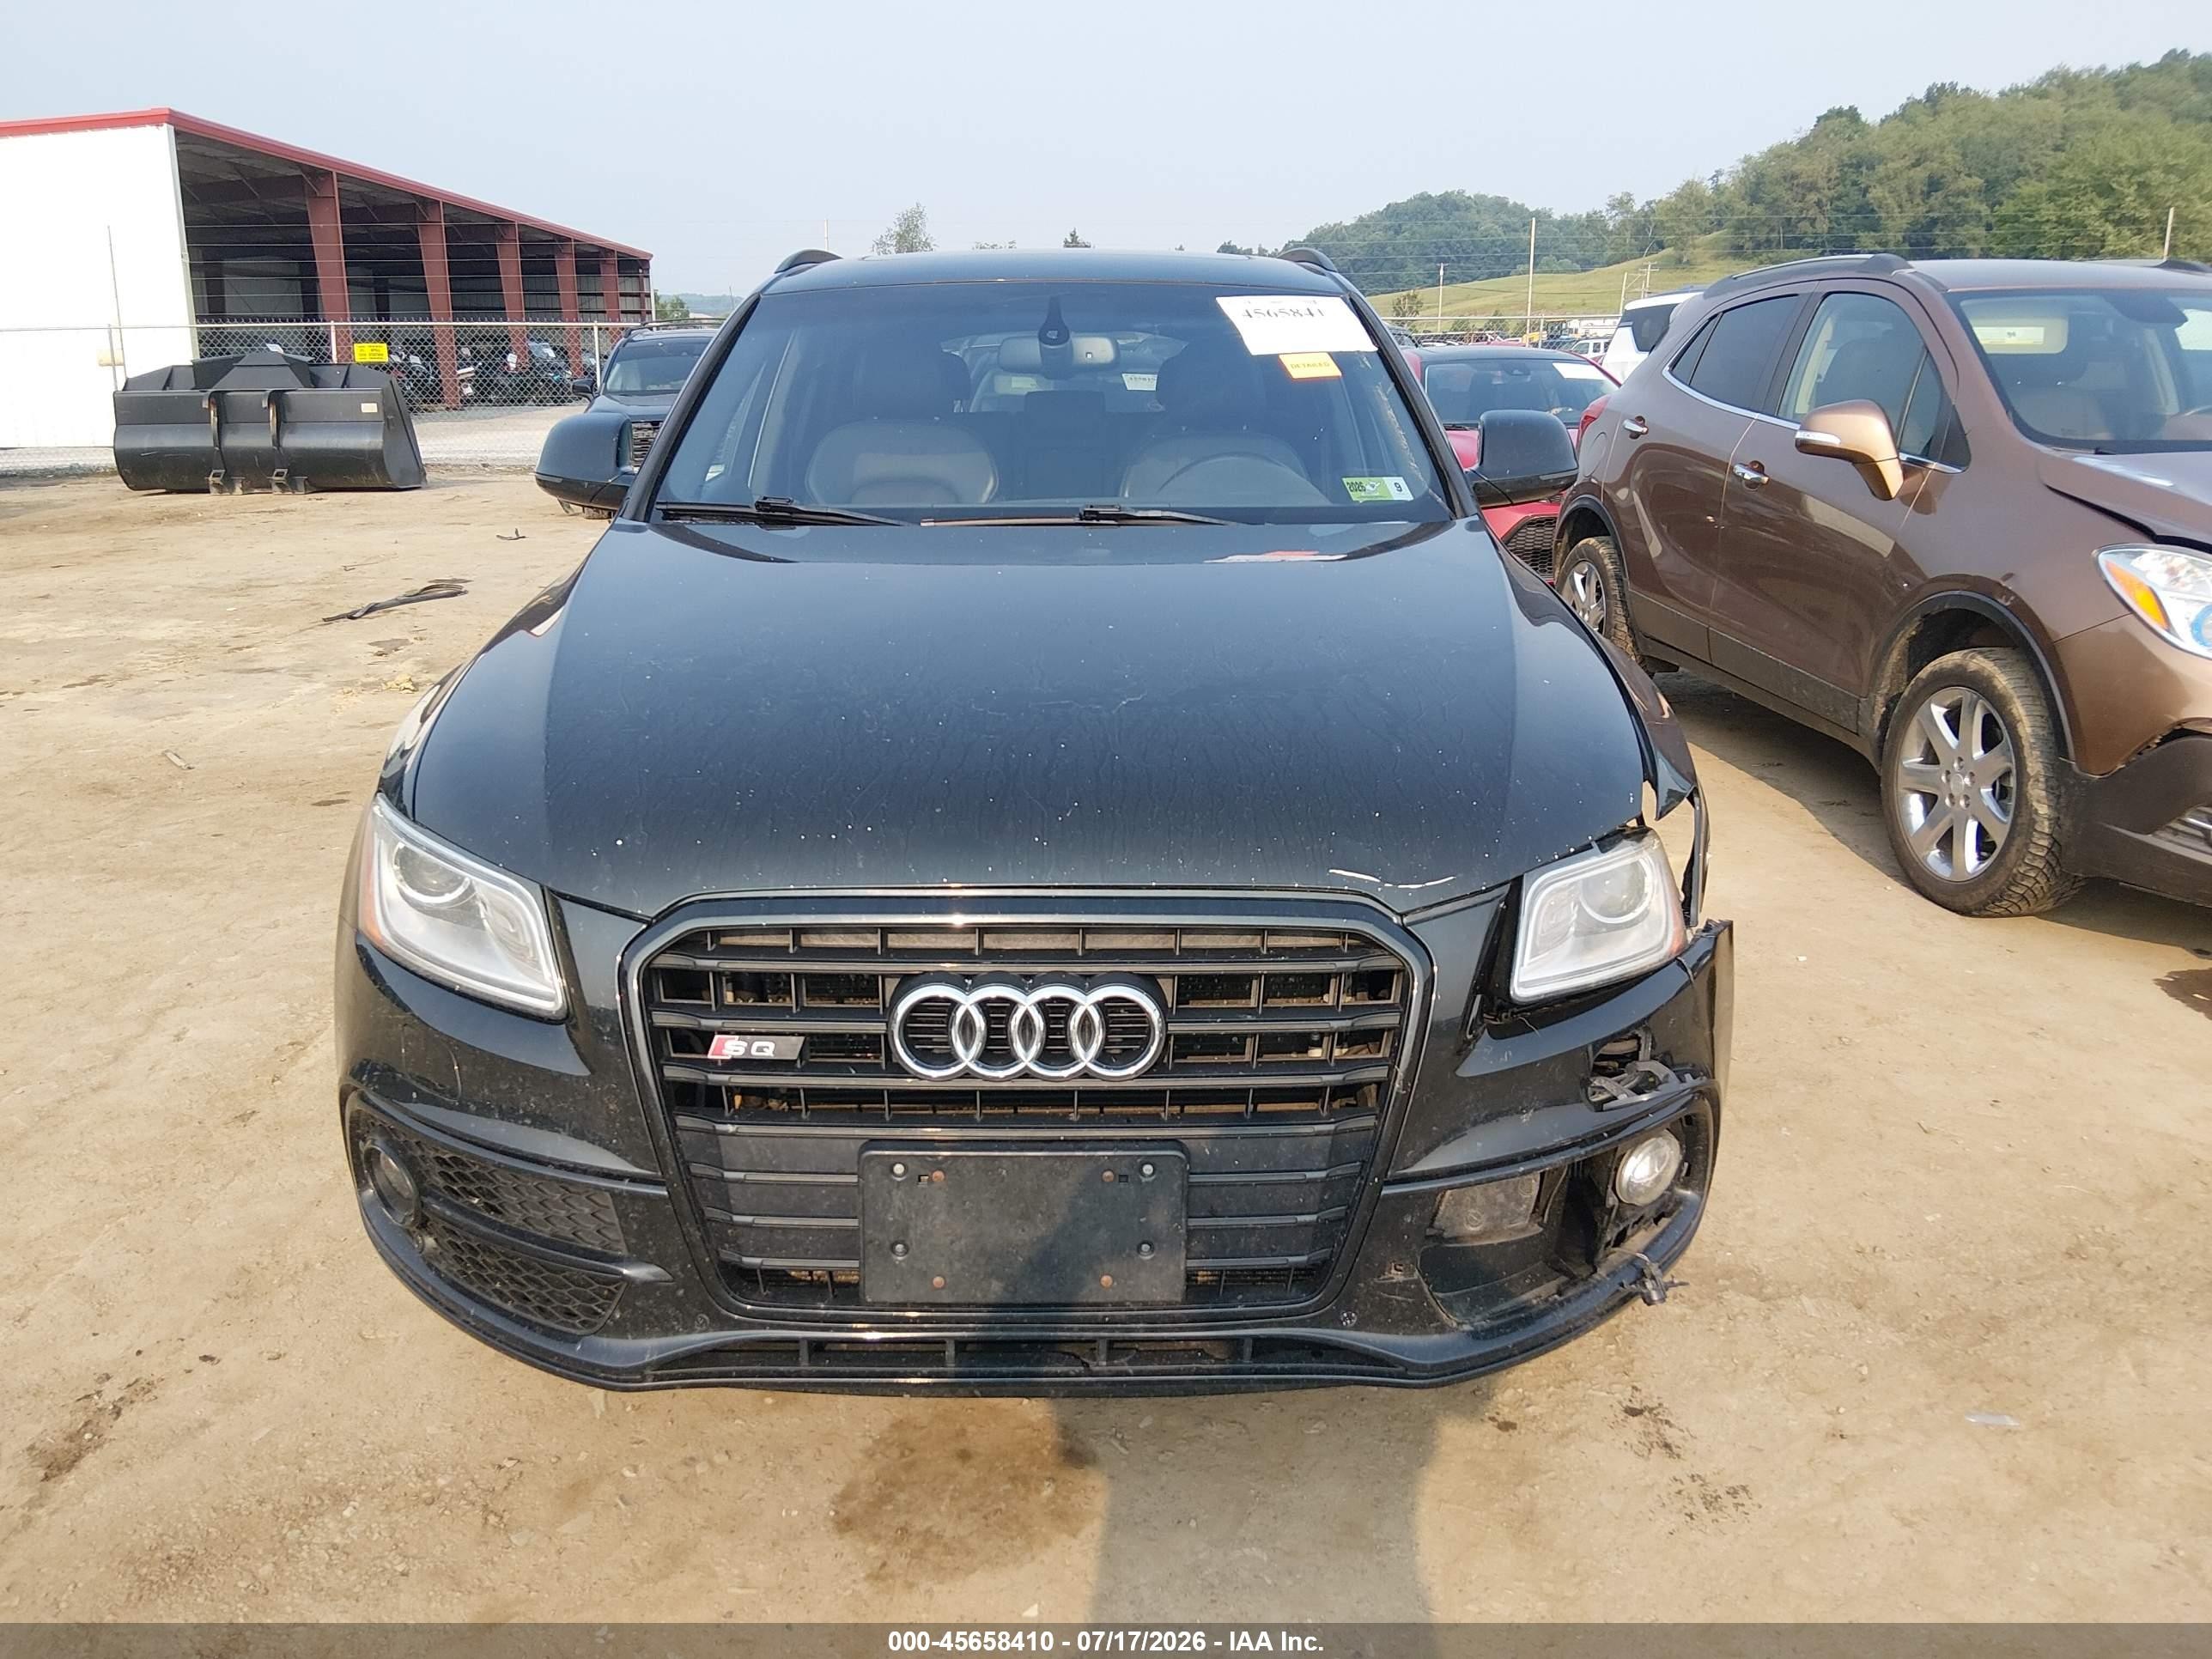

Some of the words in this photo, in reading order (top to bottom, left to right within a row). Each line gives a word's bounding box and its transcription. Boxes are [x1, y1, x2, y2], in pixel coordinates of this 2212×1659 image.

[1346, 482, 1366, 492] 2026
[1395, 483, 1403, 492] 9
[722, 1040, 775, 1057] SQ
